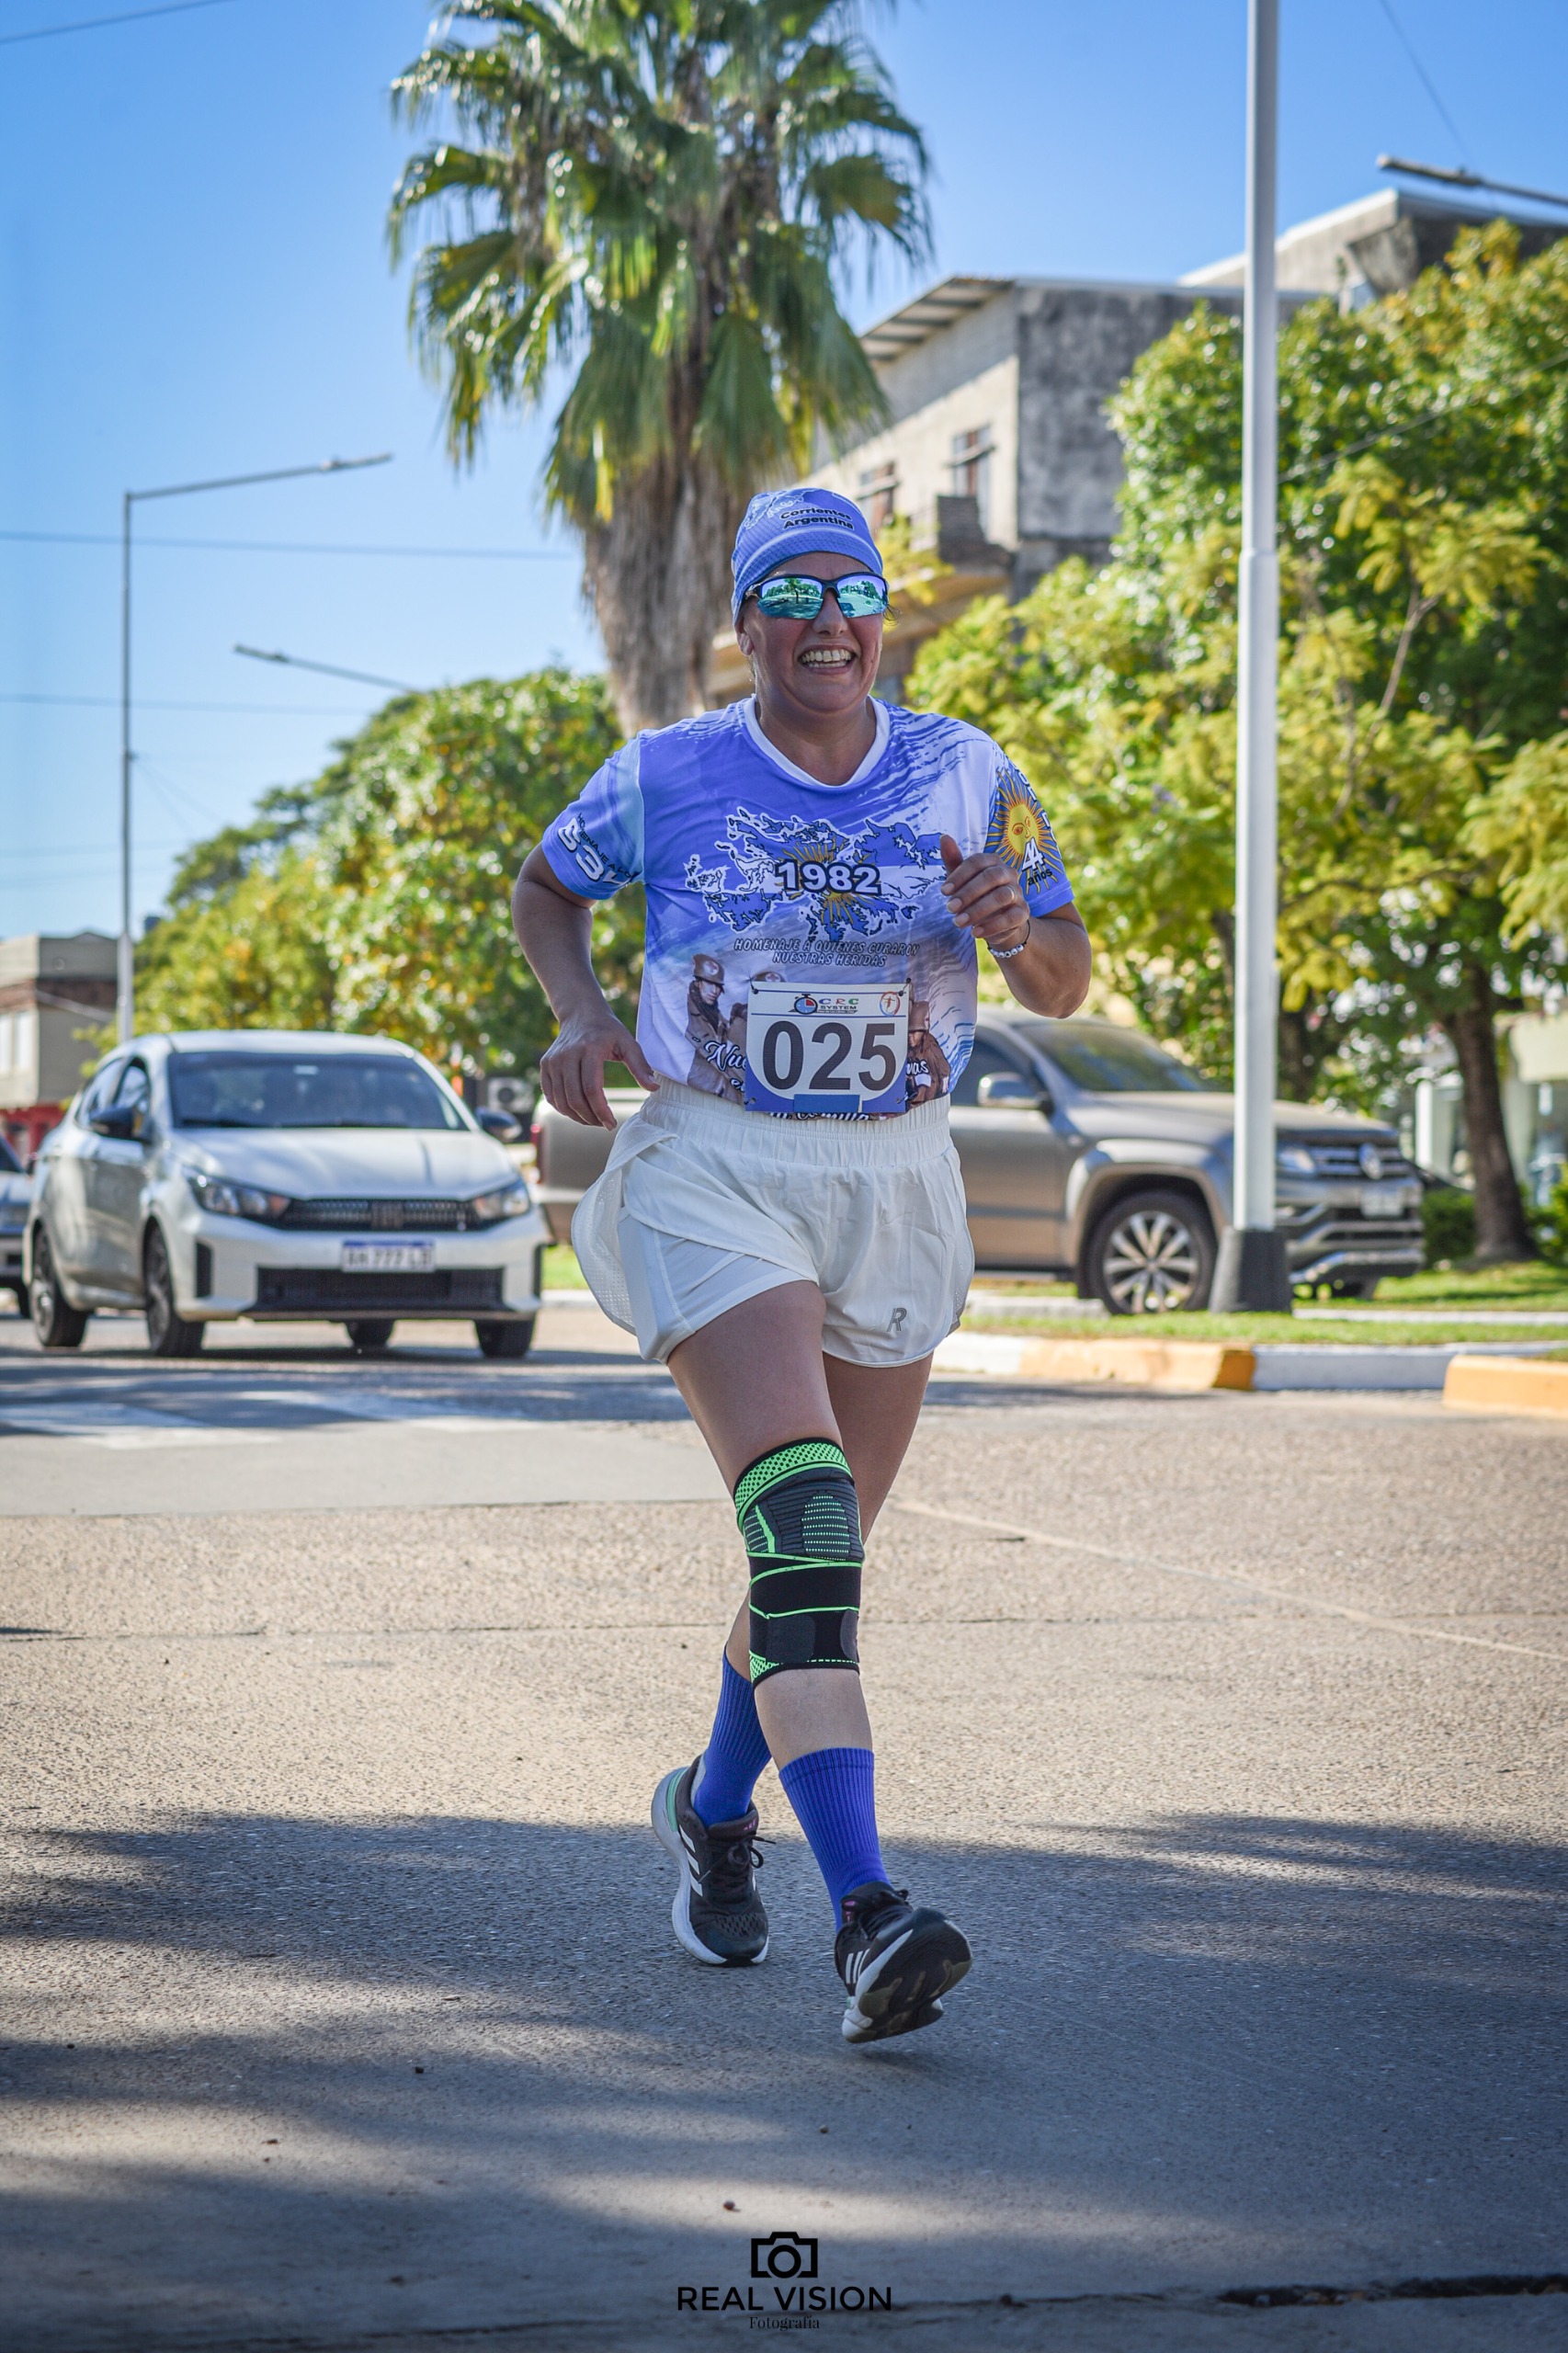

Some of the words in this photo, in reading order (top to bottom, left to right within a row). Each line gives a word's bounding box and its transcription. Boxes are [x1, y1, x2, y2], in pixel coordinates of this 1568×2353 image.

[780, 507, 852, 521] Corrientes
[783, 516, 854, 530] Argentina
[577, 813, 609, 865] HOENAJE
[774, 858, 882, 896] 1982
[1028, 869, 1052, 886] años
[733, 938, 801, 952] HOMENAJE
[814, 939, 866, 955] QUIENES
[868, 942, 920, 957] CURARON
[772, 950, 834, 966] NUESTRAS
[835, 953, 888, 968] HERIDAS
[762, 1020, 896, 1091] 025
